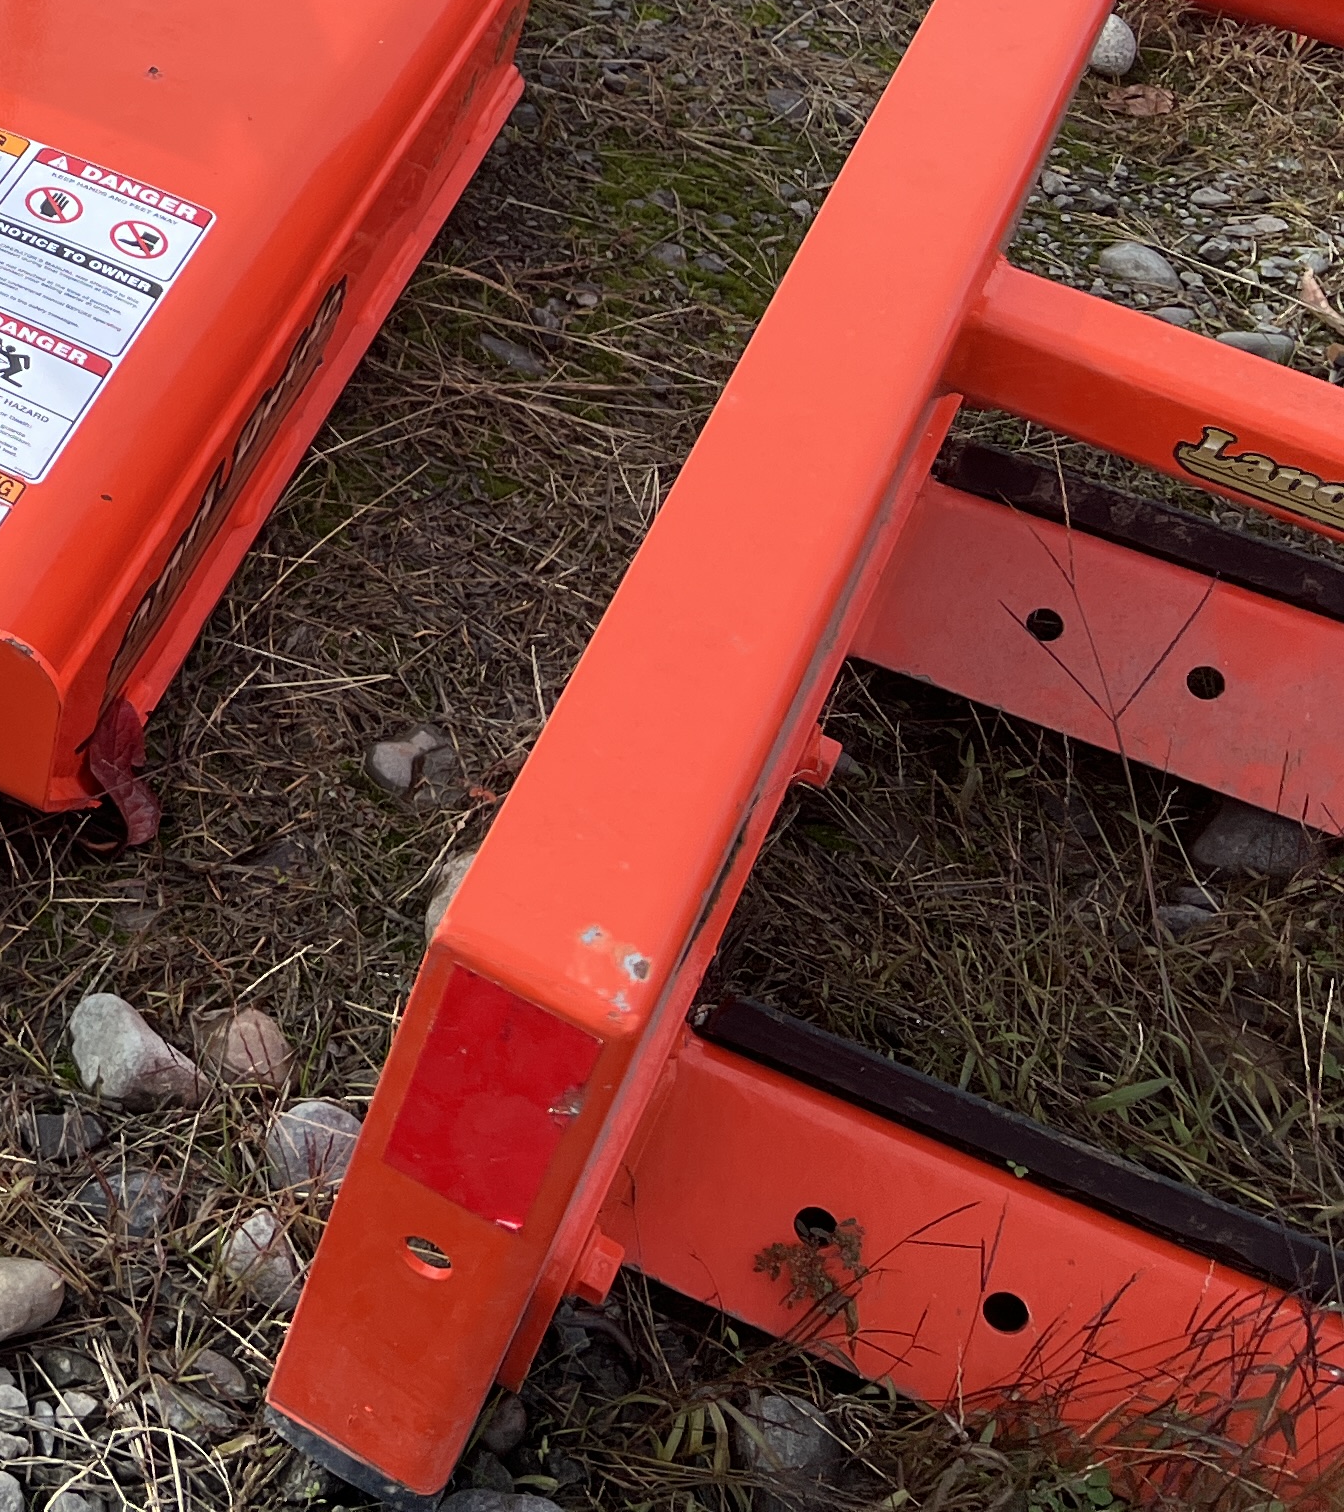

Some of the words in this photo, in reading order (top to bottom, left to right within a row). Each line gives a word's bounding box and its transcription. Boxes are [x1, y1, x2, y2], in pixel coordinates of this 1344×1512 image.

[50, 171, 75, 185] KEEP
[74, 181, 108, 198] HANDS
[106, 193, 128, 206] AND
[127, 201, 152, 215] FEET
[151, 211, 180, 226] AWAY
[78, 165, 200, 221] DANGER
[58, 247, 87, 265] TO
[85, 258, 153, 293] OWNER
[2, 398, 51, 424] HAZARD
